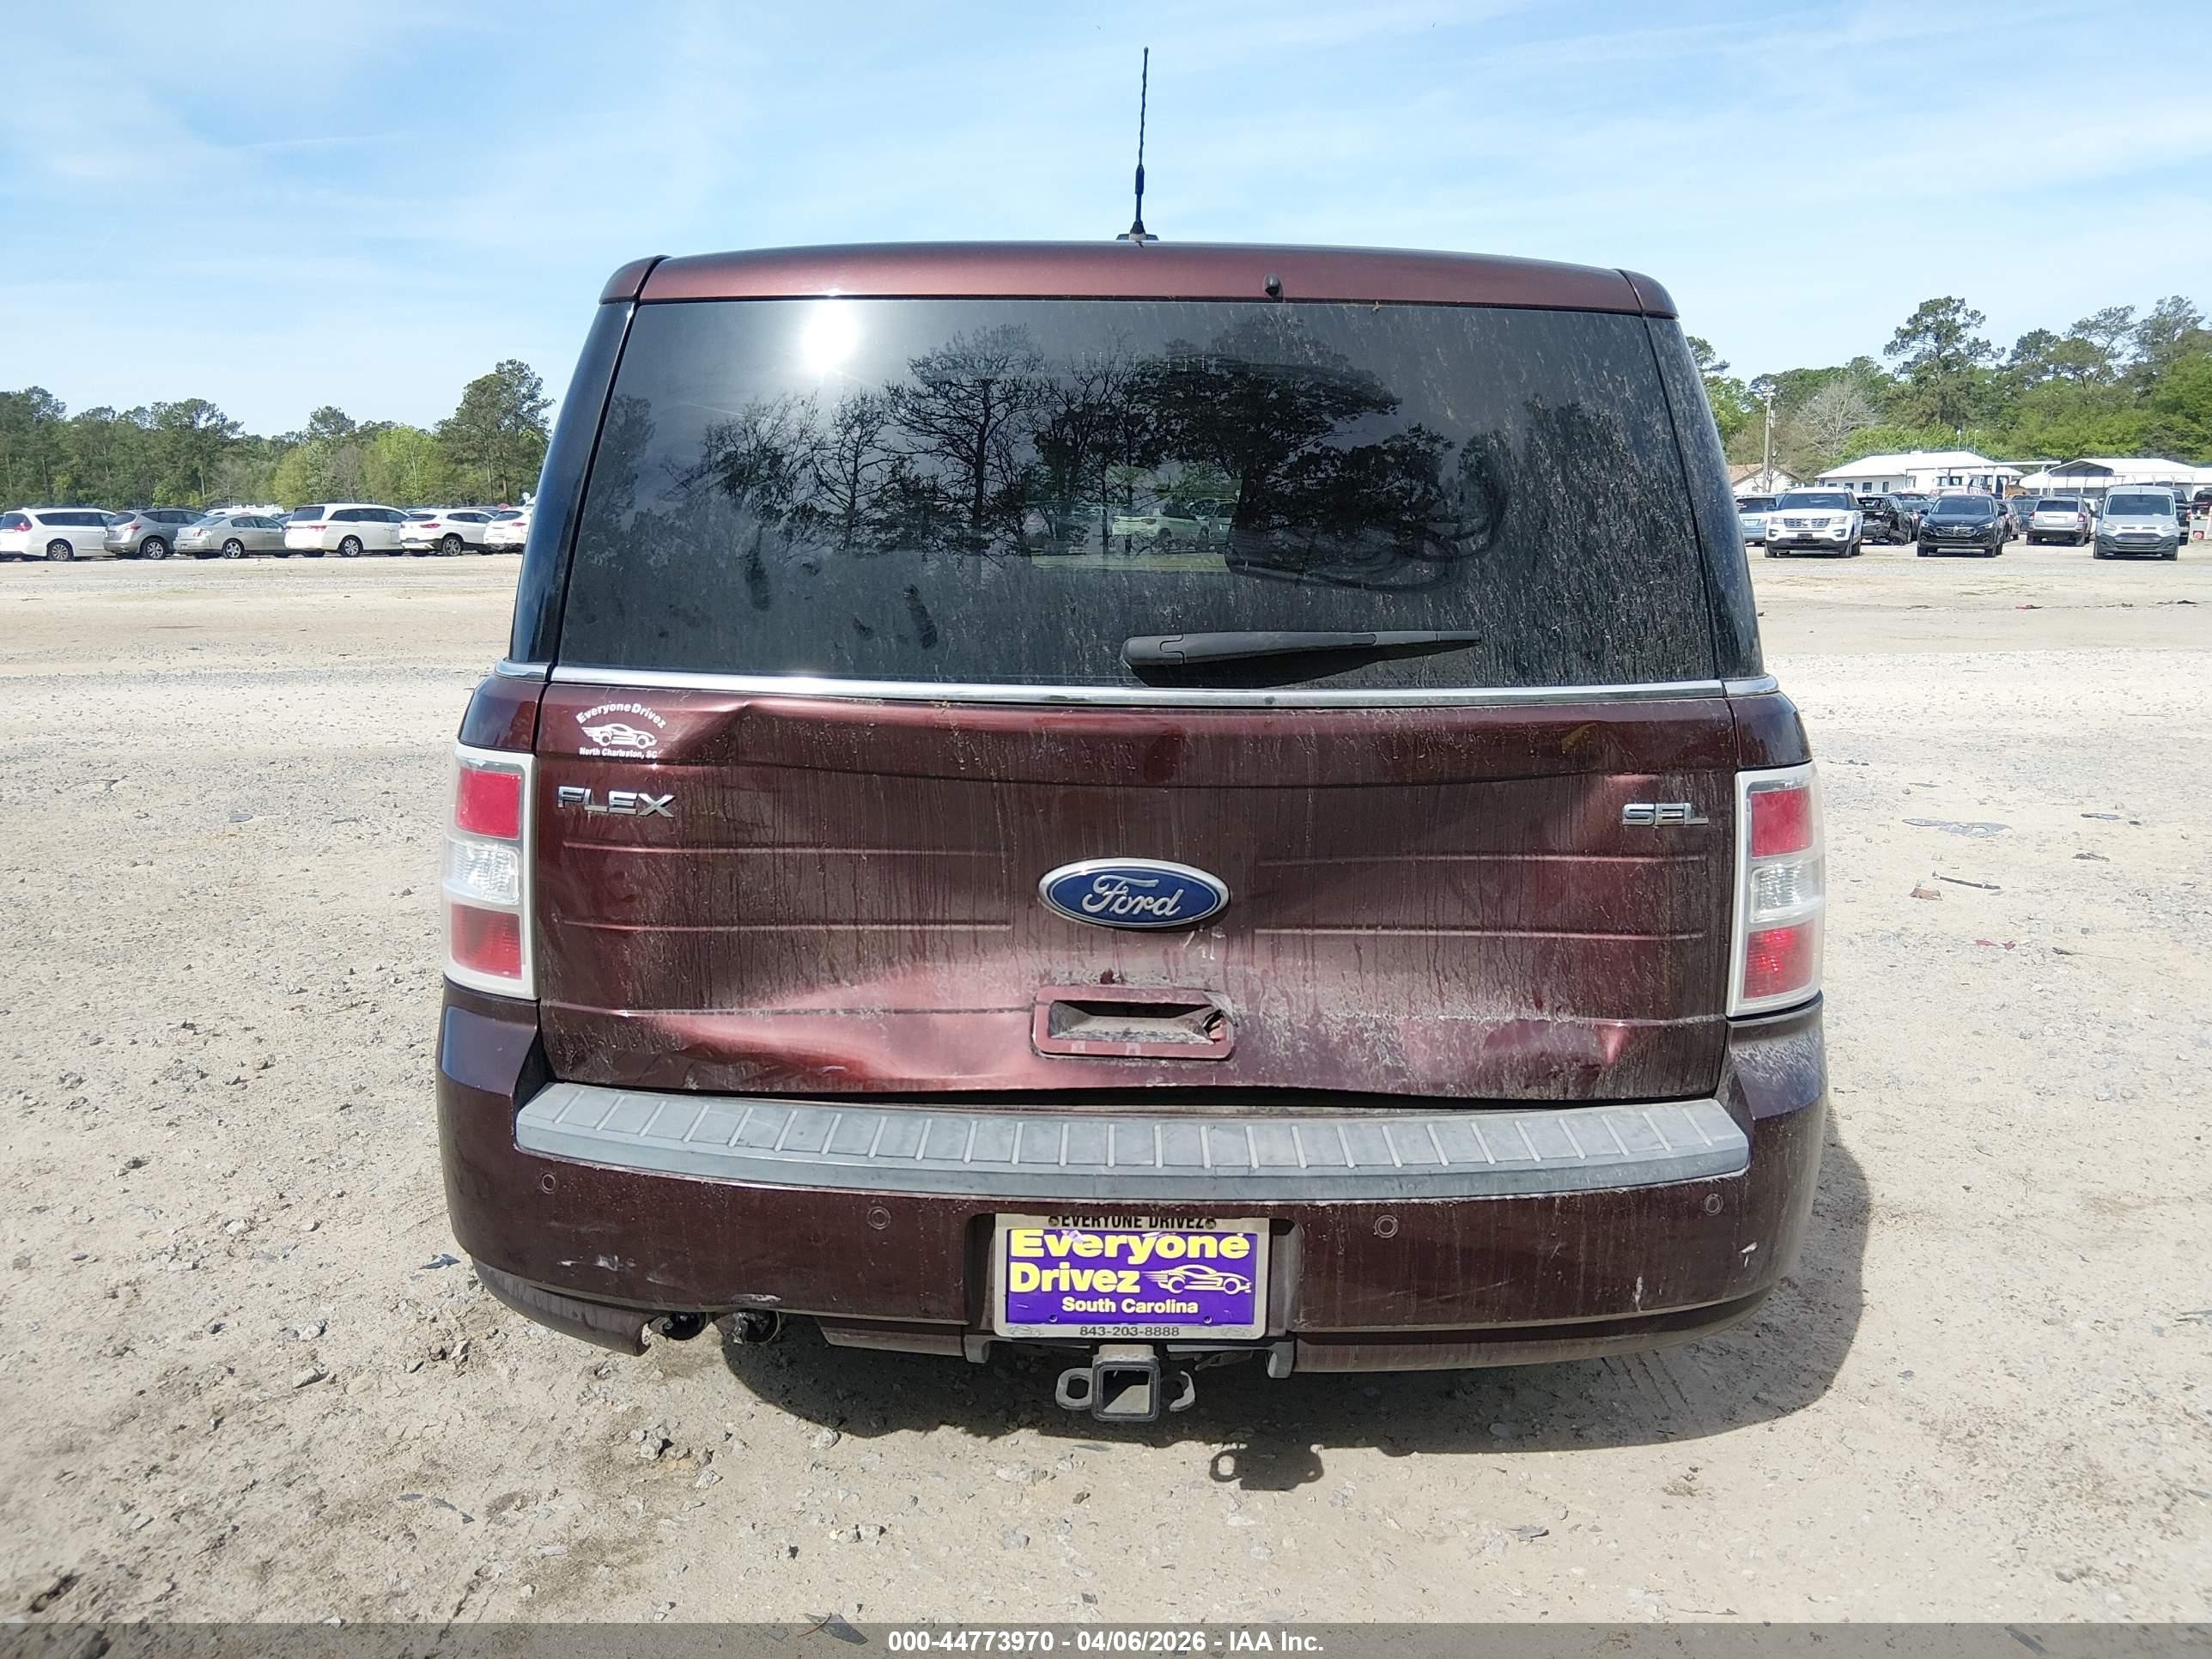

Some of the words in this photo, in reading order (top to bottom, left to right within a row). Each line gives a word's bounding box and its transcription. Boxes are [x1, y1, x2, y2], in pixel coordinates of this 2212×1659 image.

[575, 703, 631, 724] Everyone
[631, 703, 666, 728] Drivez
[579, 747, 600, 756] North
[602, 748, 644, 759] Charleston,
[646, 750, 658, 759] SC
[557, 786, 676, 817] FLEX
[1622, 803, 1709, 825] SEL
[1082, 875, 1184, 916] Ford
[1061, 1216, 1142, 1228] EVERYONE
[1149, 1217, 1204, 1229] DRIVEZ
[1010, 1229, 1250, 1265] Everyone
[1009, 1261, 1140, 1293] Drivez
[1061, 1297, 1116, 1313] South
[1121, 1297, 1199, 1314] Carolina
[1079, 1326, 1180, 1336] 843-203-8888
